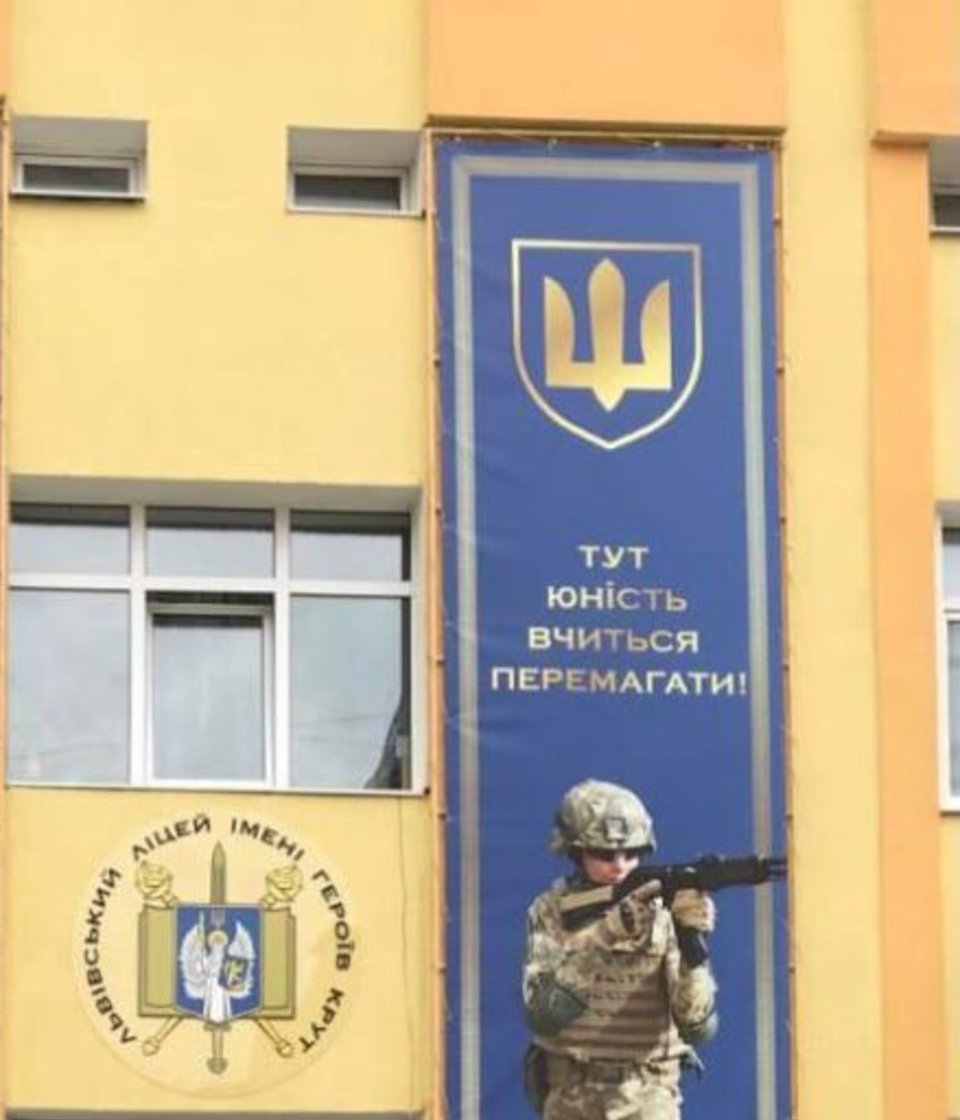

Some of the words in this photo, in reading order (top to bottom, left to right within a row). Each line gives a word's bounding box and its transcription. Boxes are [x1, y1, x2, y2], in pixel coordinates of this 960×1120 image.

[580, 545, 649, 569] ТУТ
[547, 581, 688, 612] ЮНІСТЬ
[528, 626, 699, 653] ВЧИТЬСЯ
[491, 666, 747, 695] ПЕРЕМАГАТИ!
[131, 812, 212, 861] ЛІЦЕЙ
[230, 817, 306, 862] ІМЕНІ
[311, 868, 356, 972] ГЕРОЇВ
[84, 867, 136, 1045] ЛЬВІВСЬКИЙ
[298, 987, 345, 1054] КРУТ
